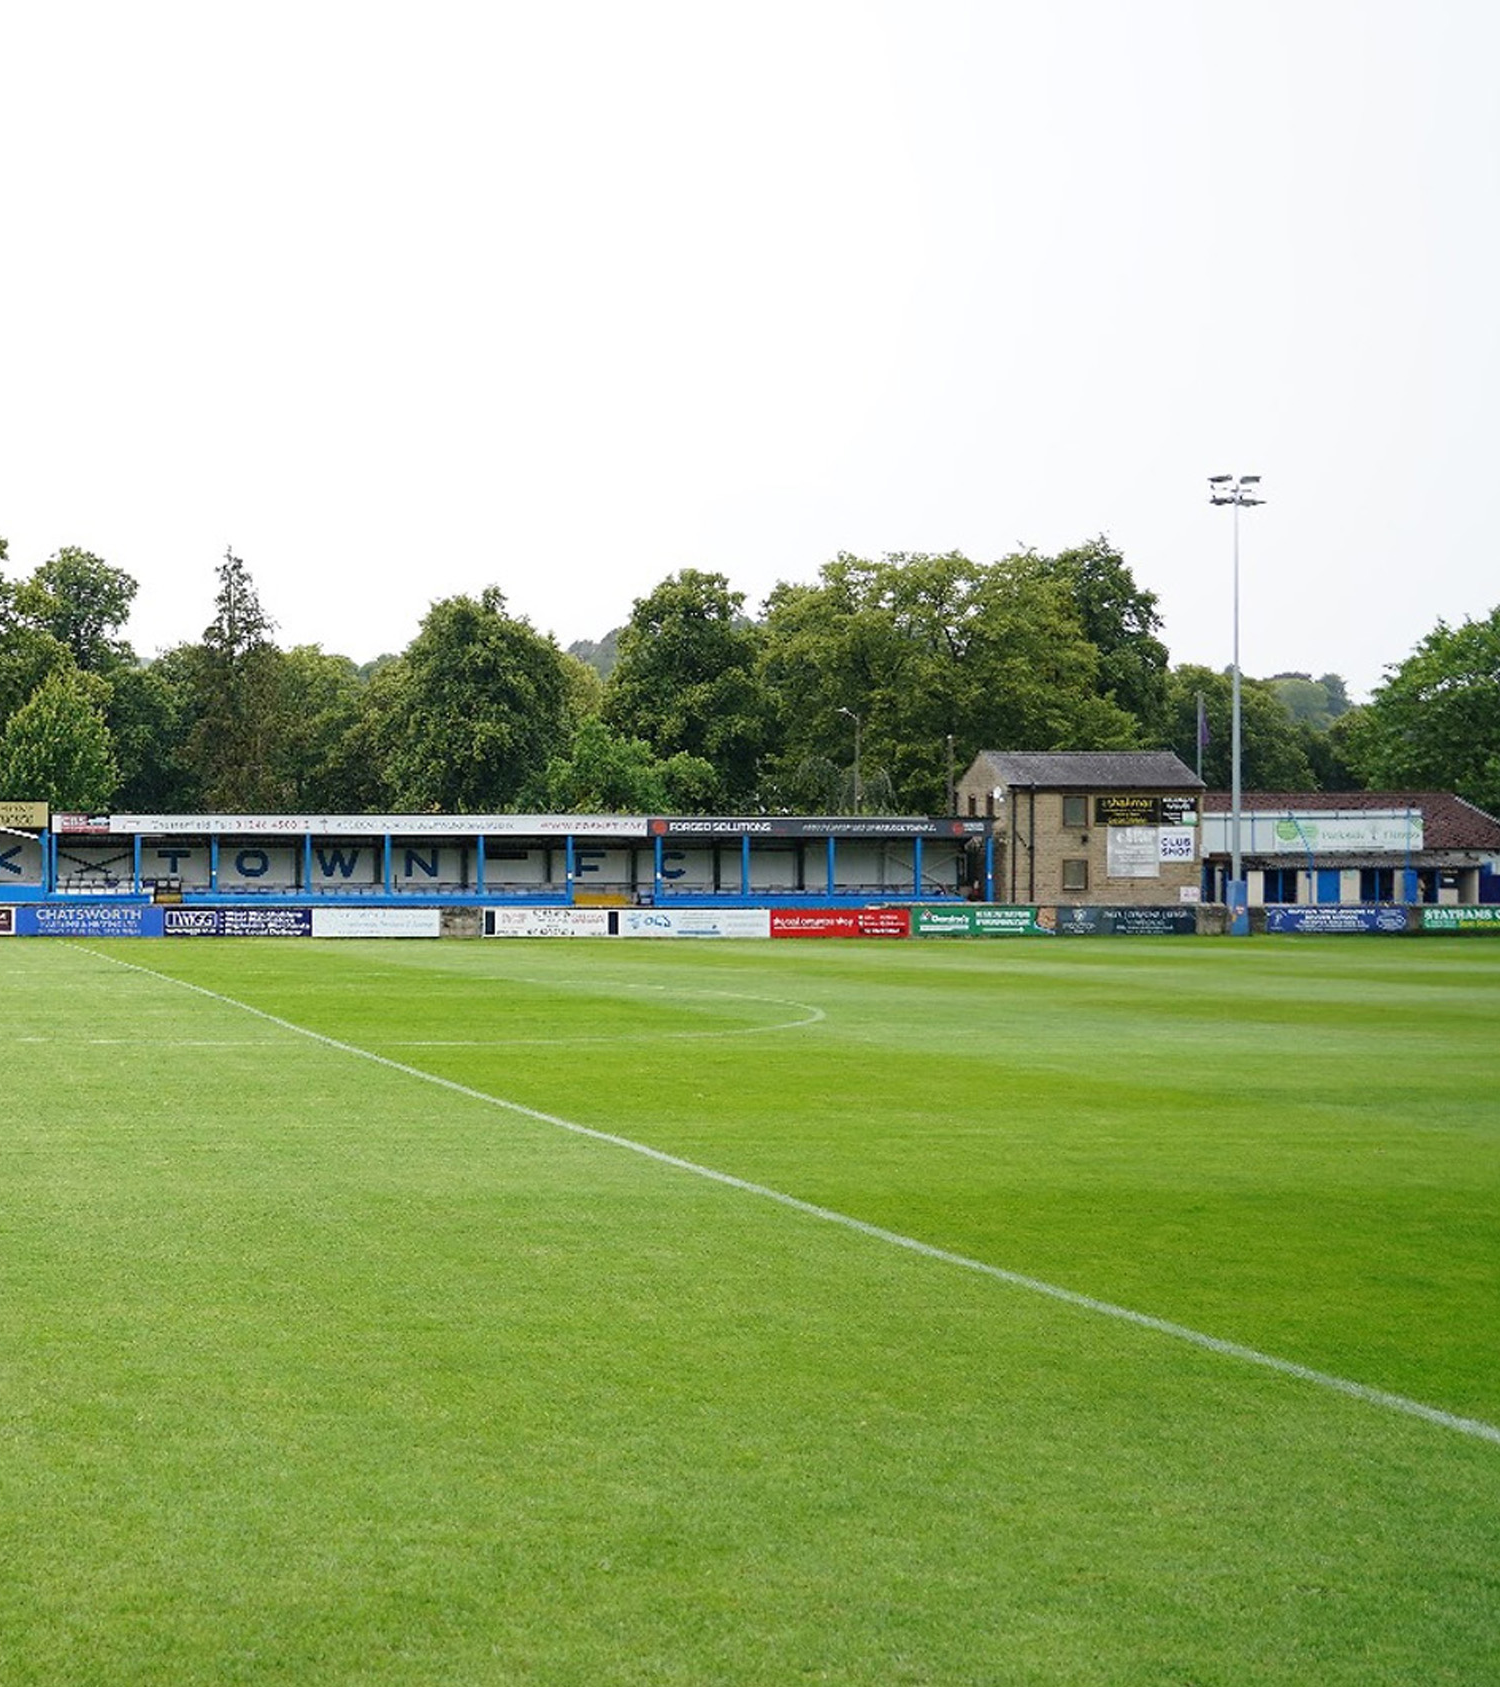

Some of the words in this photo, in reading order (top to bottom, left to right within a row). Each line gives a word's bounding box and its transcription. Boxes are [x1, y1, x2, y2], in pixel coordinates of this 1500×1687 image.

[669, 822, 711, 831] FORGED
[713, 822, 771, 831] SOLUTIONS
[1160, 838, 1191, 847] CLUB
[1160, 847, 1192, 857] SHOP
[157, 850, 437, 877] TOWN
[35, 909, 142, 920] CHATSWORTH
[1424, 909, 1492, 920] STATHAMS
